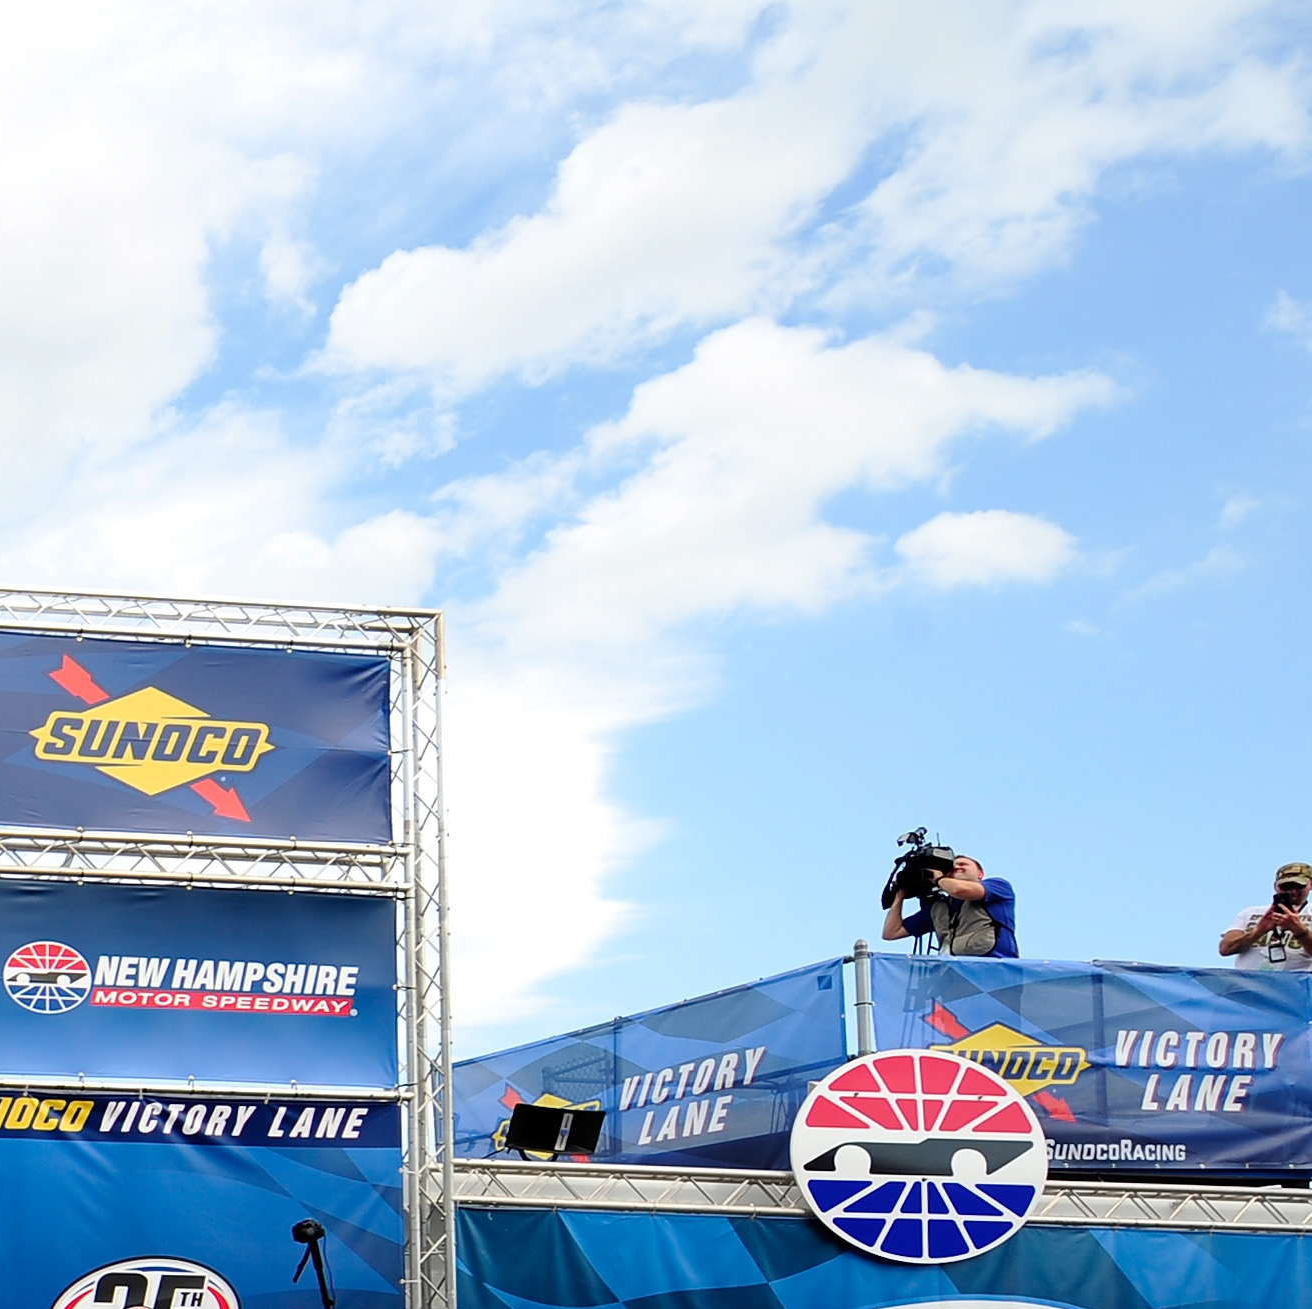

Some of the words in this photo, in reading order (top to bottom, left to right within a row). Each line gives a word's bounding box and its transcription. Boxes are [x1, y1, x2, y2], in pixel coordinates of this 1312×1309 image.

[41, 719, 265, 766] SUNOCO
[94, 955, 170, 987] NEW
[173, 956, 358, 996] HAMPSHIRE
[94, 990, 189, 1007] MOTOR
[202, 995, 349, 1016] SPEEDWAY
[1115, 1030, 1283, 1069] VICTORY
[619, 1046, 767, 1111] VICTORY
[1141, 1075, 1253, 1111] LANE
[98, 1101, 263, 1137] VICTORY
[267, 1106, 368, 1139] LANE
[638, 1095, 733, 1145] LANE
